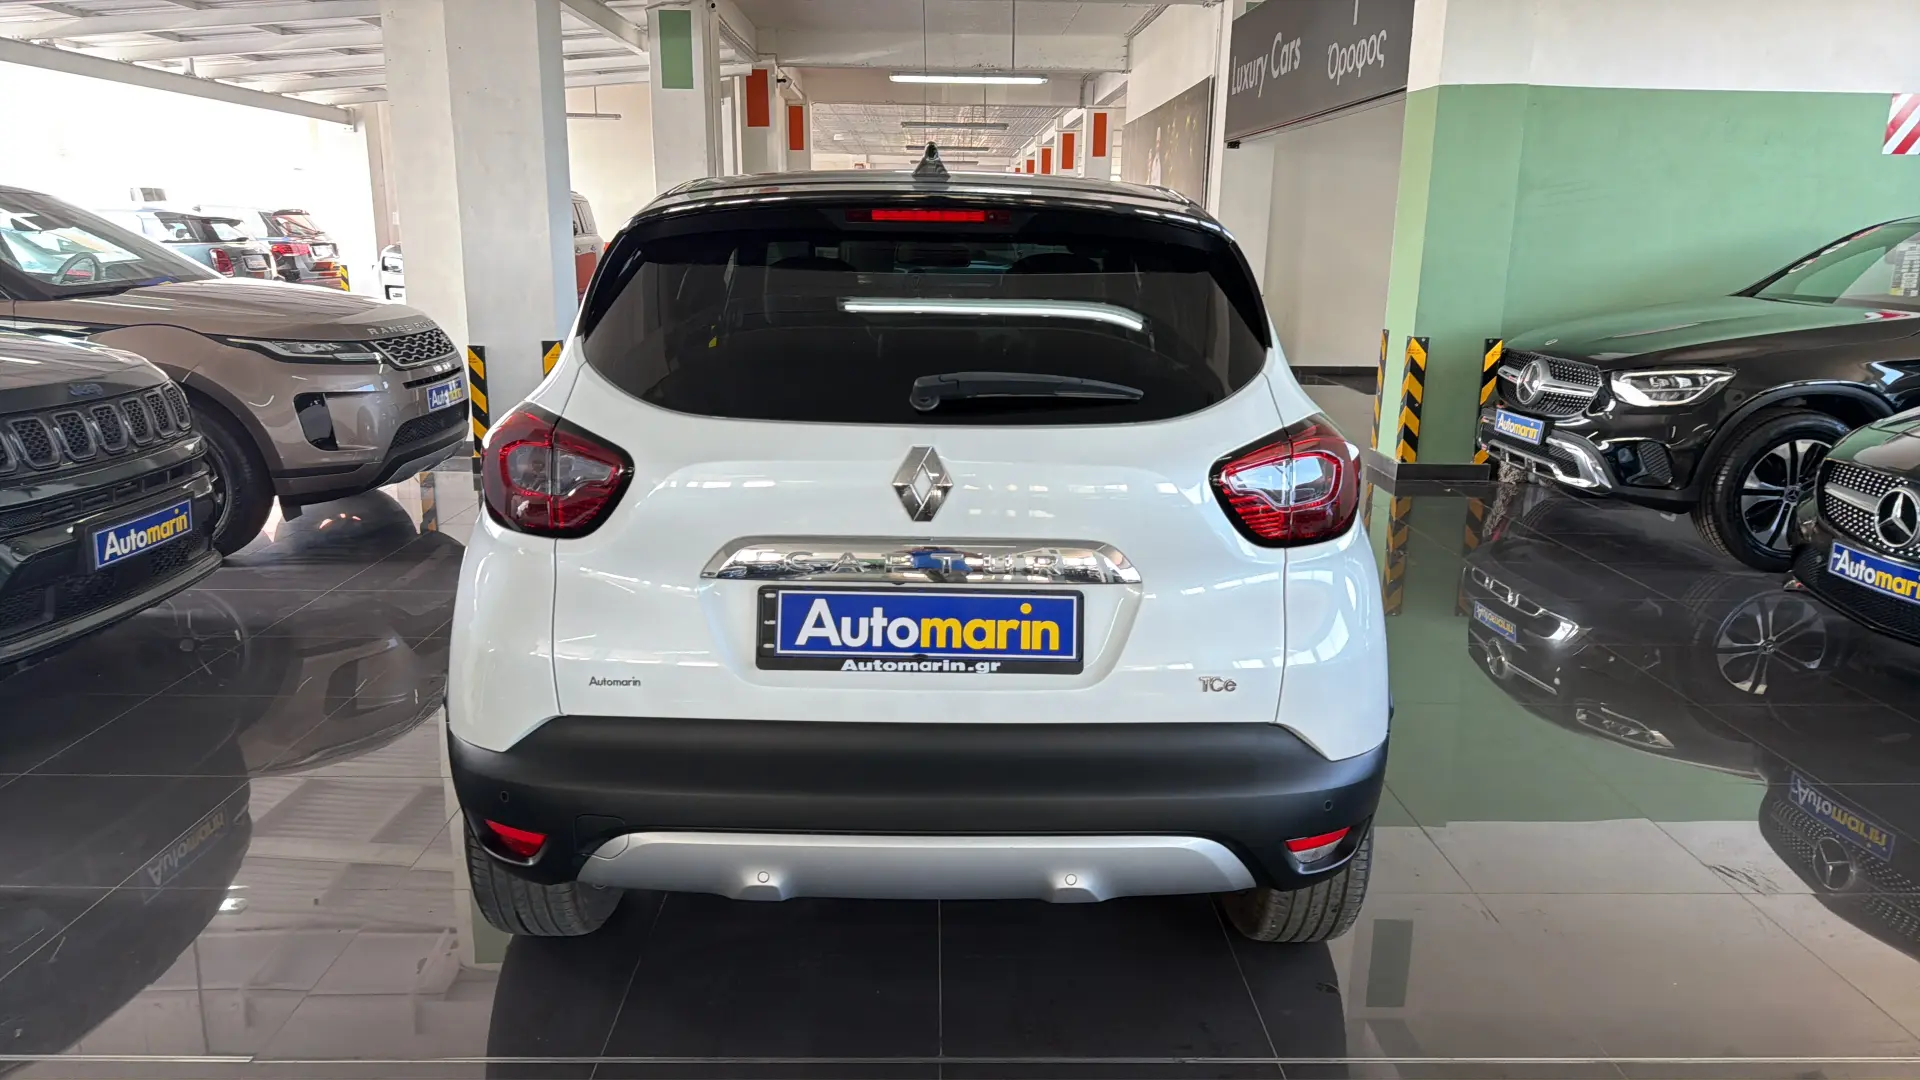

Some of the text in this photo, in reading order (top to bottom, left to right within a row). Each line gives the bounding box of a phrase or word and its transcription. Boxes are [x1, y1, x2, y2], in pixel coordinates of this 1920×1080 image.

[1231, 32, 1301, 98] Luxury Cars
[366, 324, 412, 335] RANGE
[103, 508, 188, 561] Automarin
[784, 549, 1063, 576] CAPTUR
[795, 598, 1060, 651] Automarin
[841, 659, 1001, 674] Automarin.gr
[588, 676, 641, 686] Automarin
[1199, 676, 1237, 692] TCe
